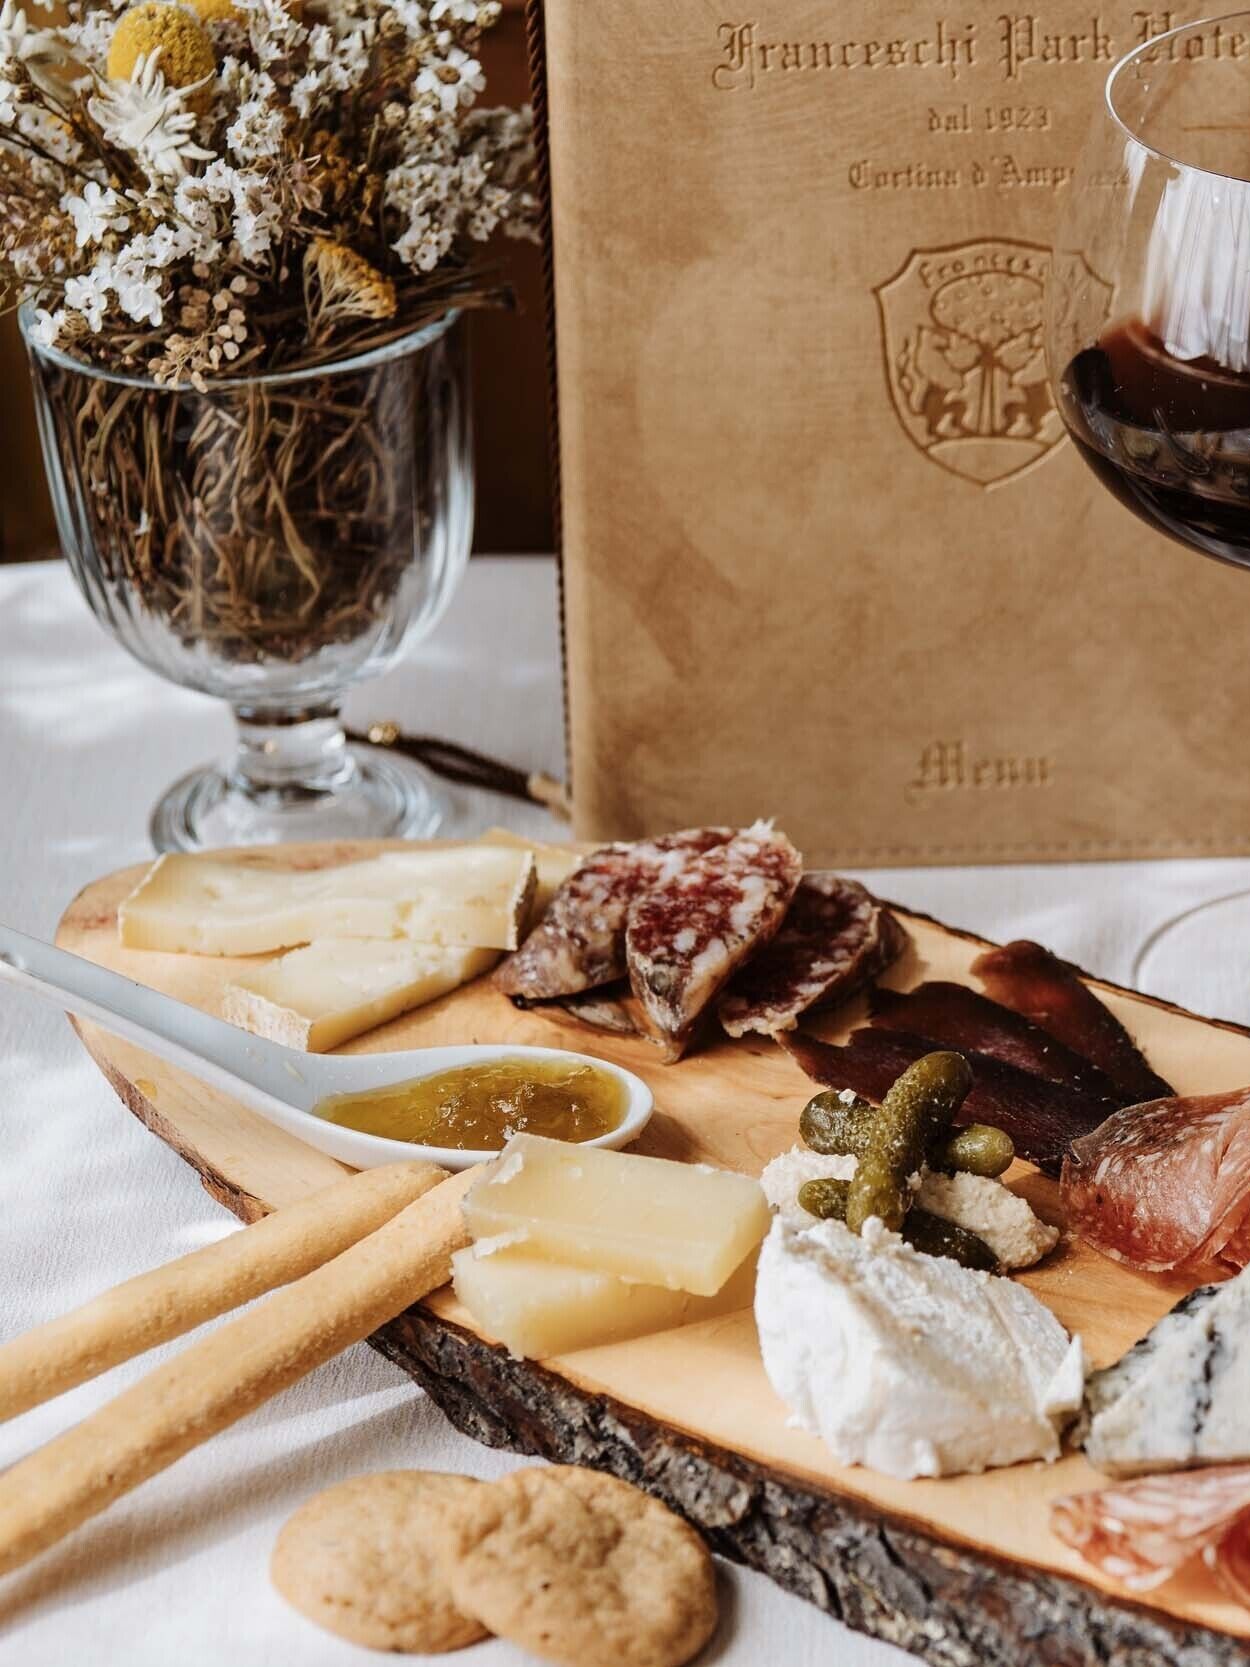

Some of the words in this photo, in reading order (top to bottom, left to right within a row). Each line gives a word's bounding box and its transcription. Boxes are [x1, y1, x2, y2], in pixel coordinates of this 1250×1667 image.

[711, 21, 976, 90] Franceschi
[999, 14, 1114, 81] Park
[928, 104, 970, 131] dal
[985, 106, 1051, 131] 1923
[848, 160, 959, 189] Cortina
[970, 154, 1130, 188] d'Amp
[903, 740, 1051, 806] Menu
